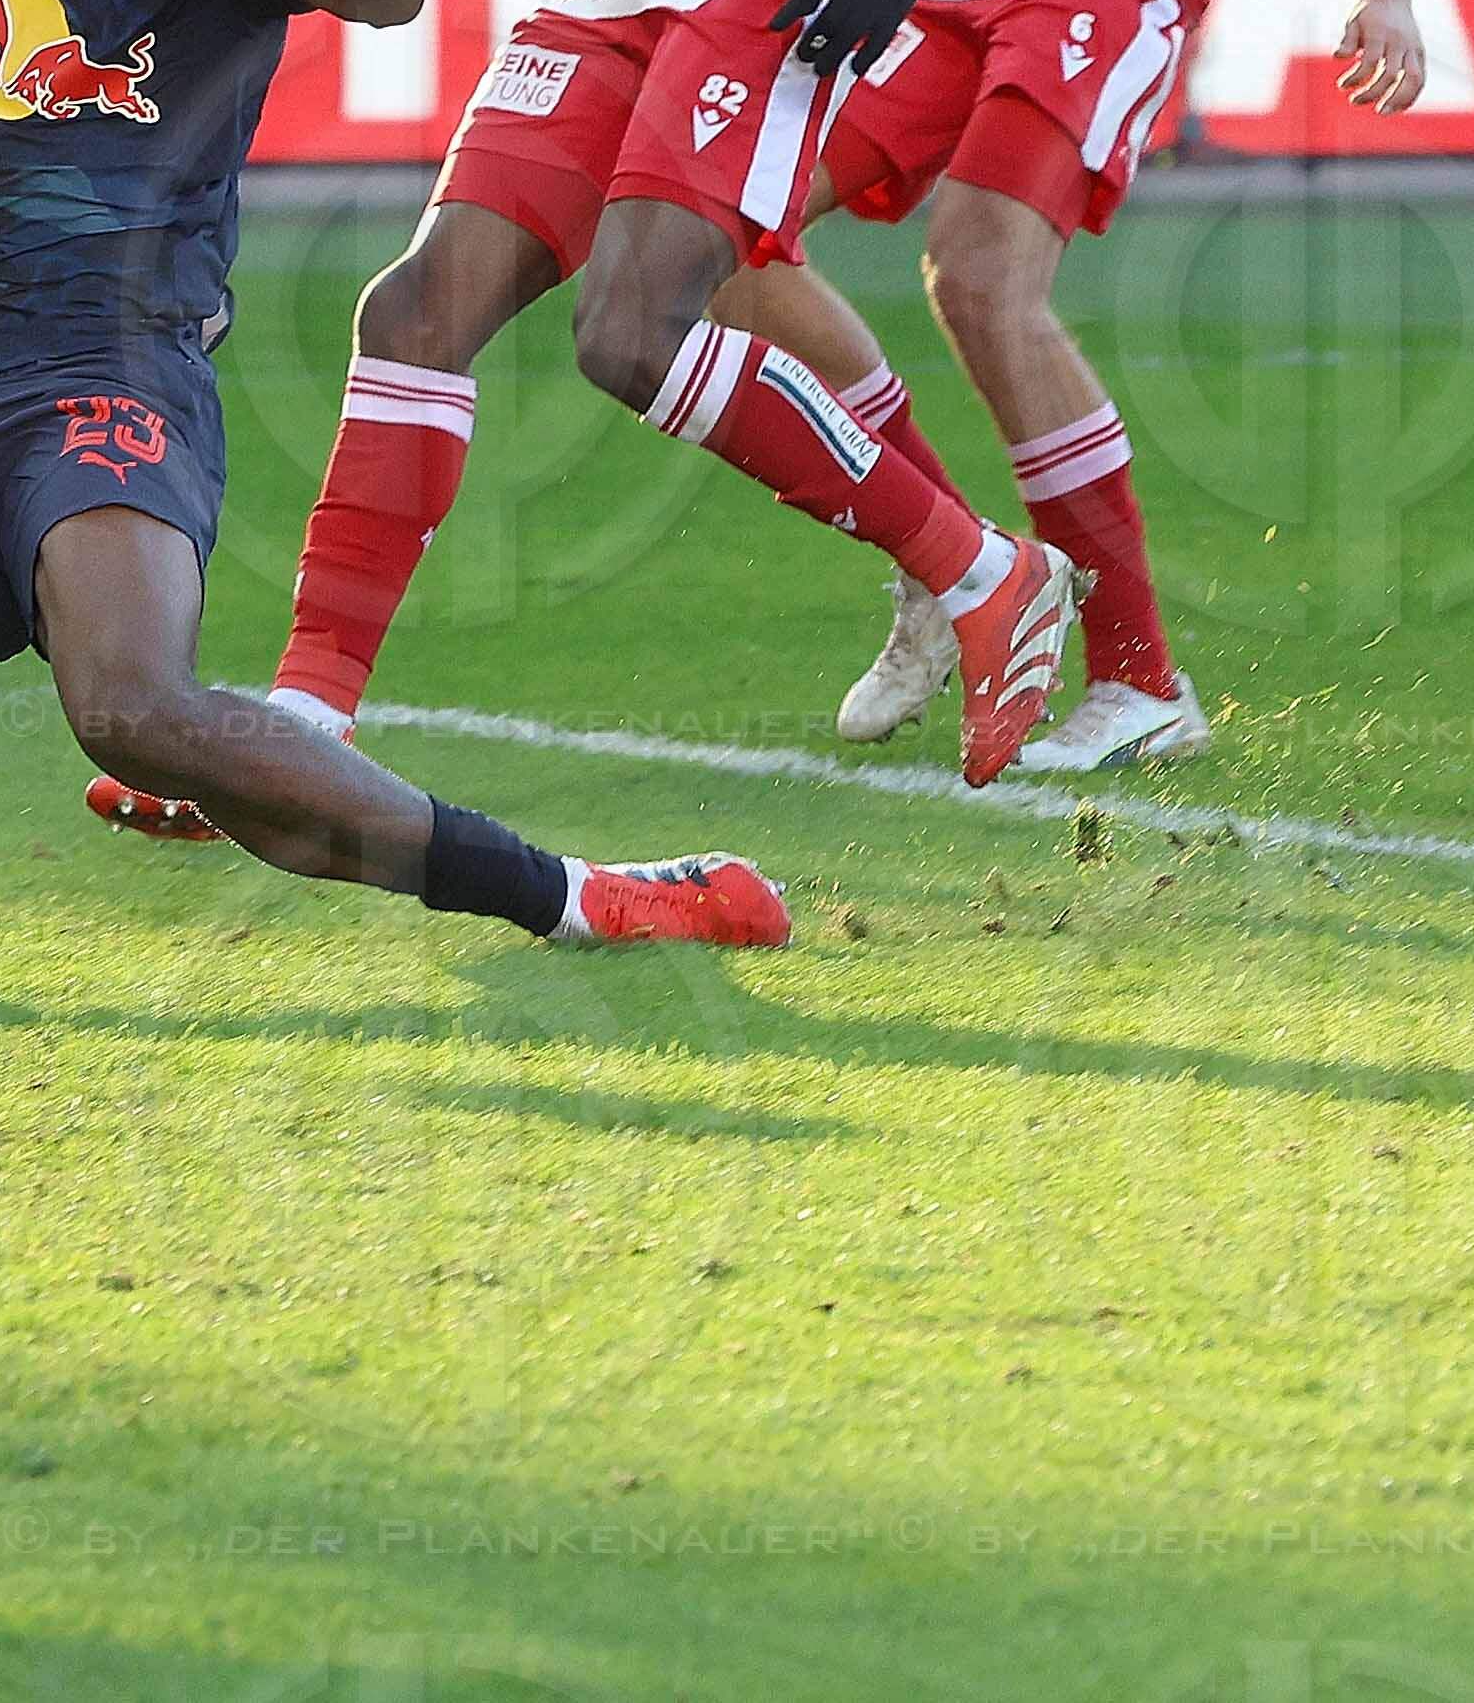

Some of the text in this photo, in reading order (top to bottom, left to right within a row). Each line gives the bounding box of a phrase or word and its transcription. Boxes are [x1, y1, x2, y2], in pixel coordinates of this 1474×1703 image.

[1068, 12, 1097, 43] 6
[500, 52, 569, 82] EINE
[699, 72, 750, 117] 82
[56, 396, 167, 465] 23
